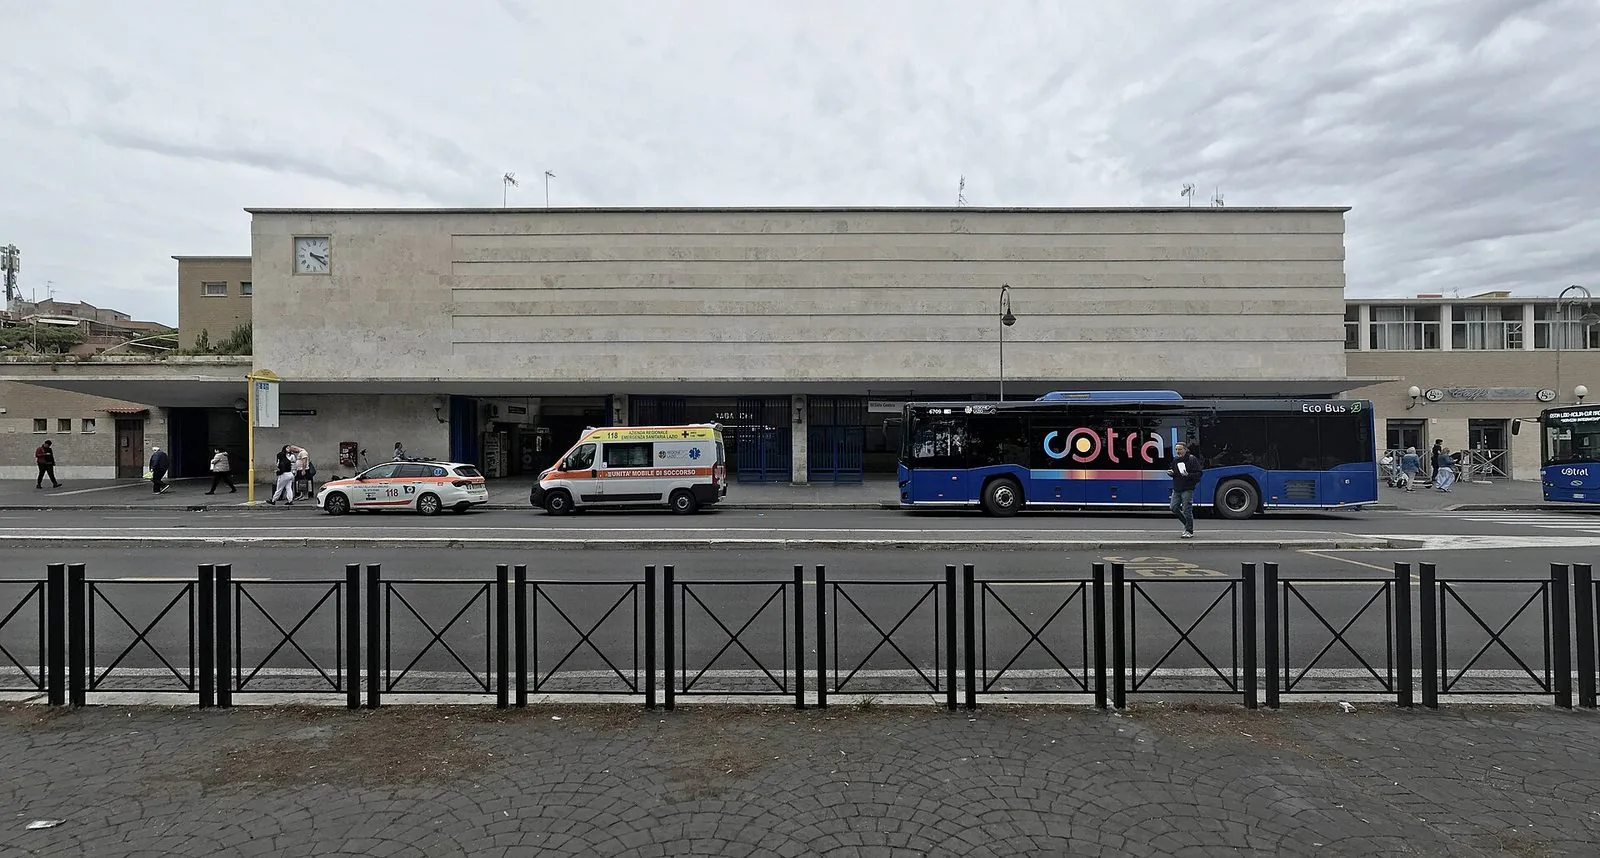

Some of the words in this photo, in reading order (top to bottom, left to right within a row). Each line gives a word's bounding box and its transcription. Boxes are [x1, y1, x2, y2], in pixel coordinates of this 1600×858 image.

[1302, 403, 1321, 413] Eco
[1324, 403, 1346, 413] Bus
[607, 431, 619, 440] 118
[1043, 427, 1178, 464] cotral
[1561, 467, 1589, 476] cotral
[385, 488, 399, 497] 118
